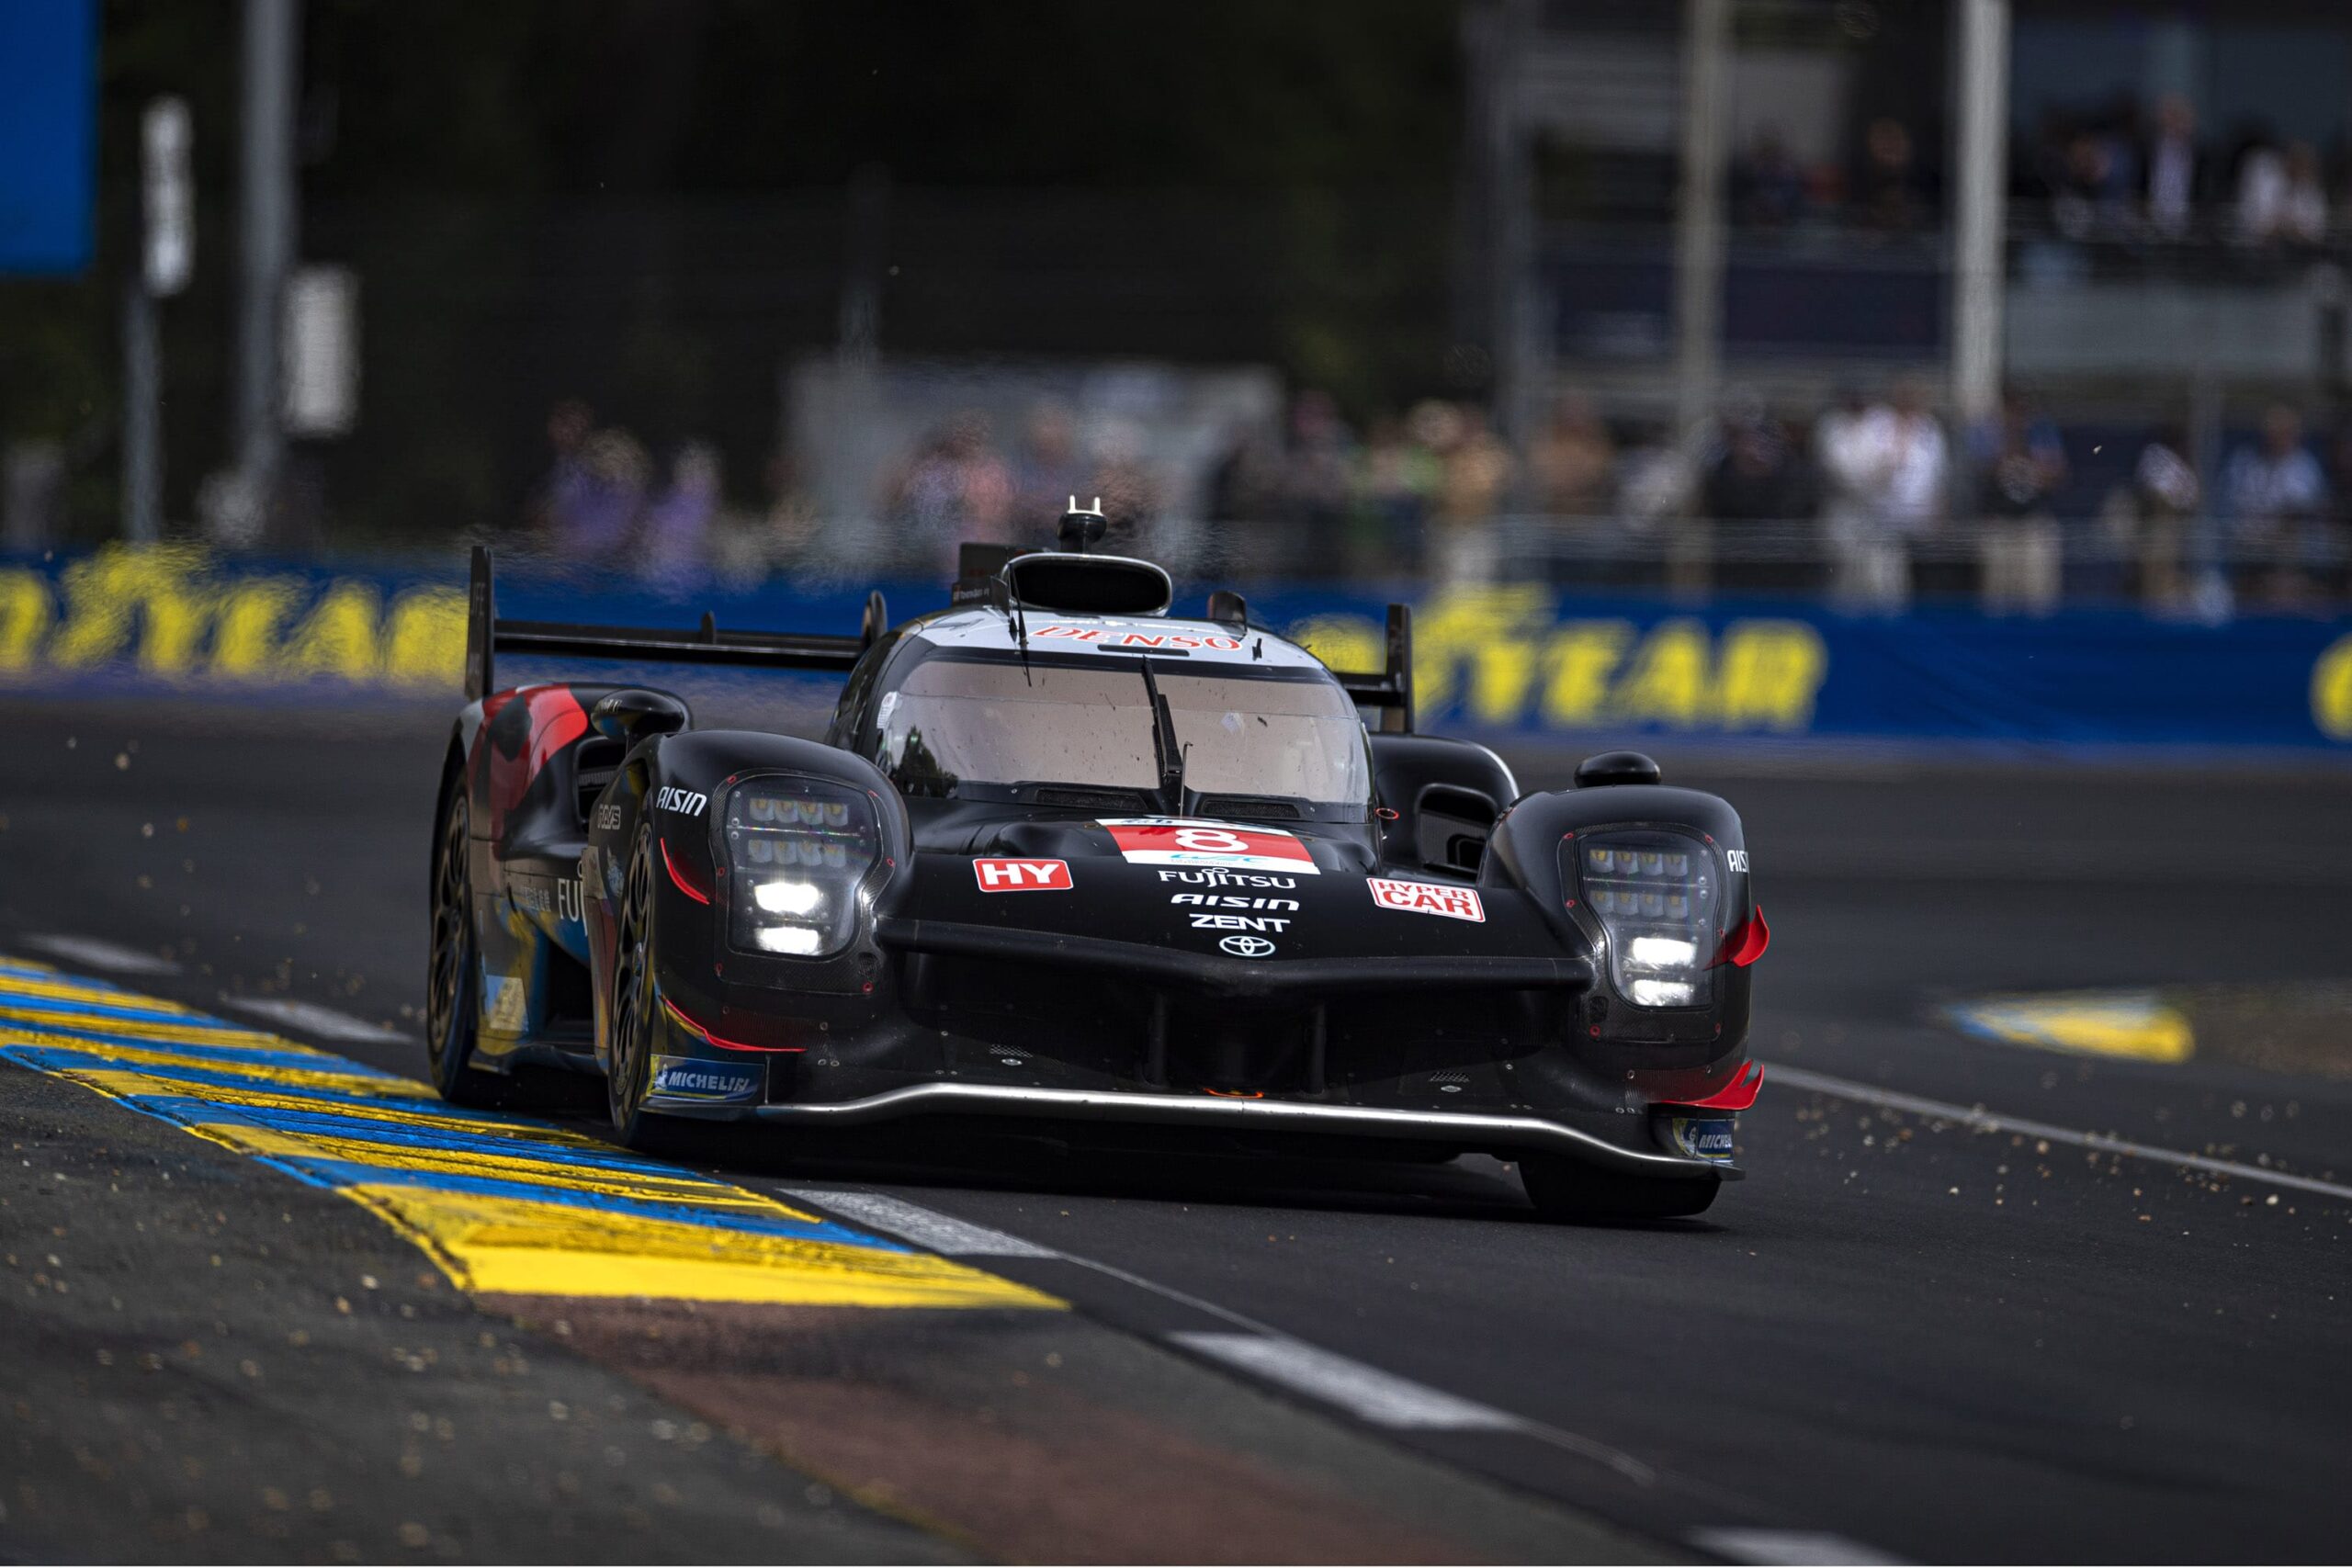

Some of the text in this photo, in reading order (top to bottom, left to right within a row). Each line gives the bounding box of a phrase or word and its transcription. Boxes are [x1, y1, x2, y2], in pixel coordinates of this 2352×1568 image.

[1030, 626, 1242, 650] DENSO
[656, 786, 707, 817] AISIN
[1175, 829, 1249, 852] 8
[981, 863, 1059, 885] HY
[1158, 868, 1296, 889] FUJITSU
[1378, 882, 1469, 899] HYPER
[1170, 894, 1300, 911] AISIN
[1383, 891, 1474, 916] CAR
[1189, 913, 1291, 932] ZENT
[668, 1071, 750, 1092] MICHELIN
